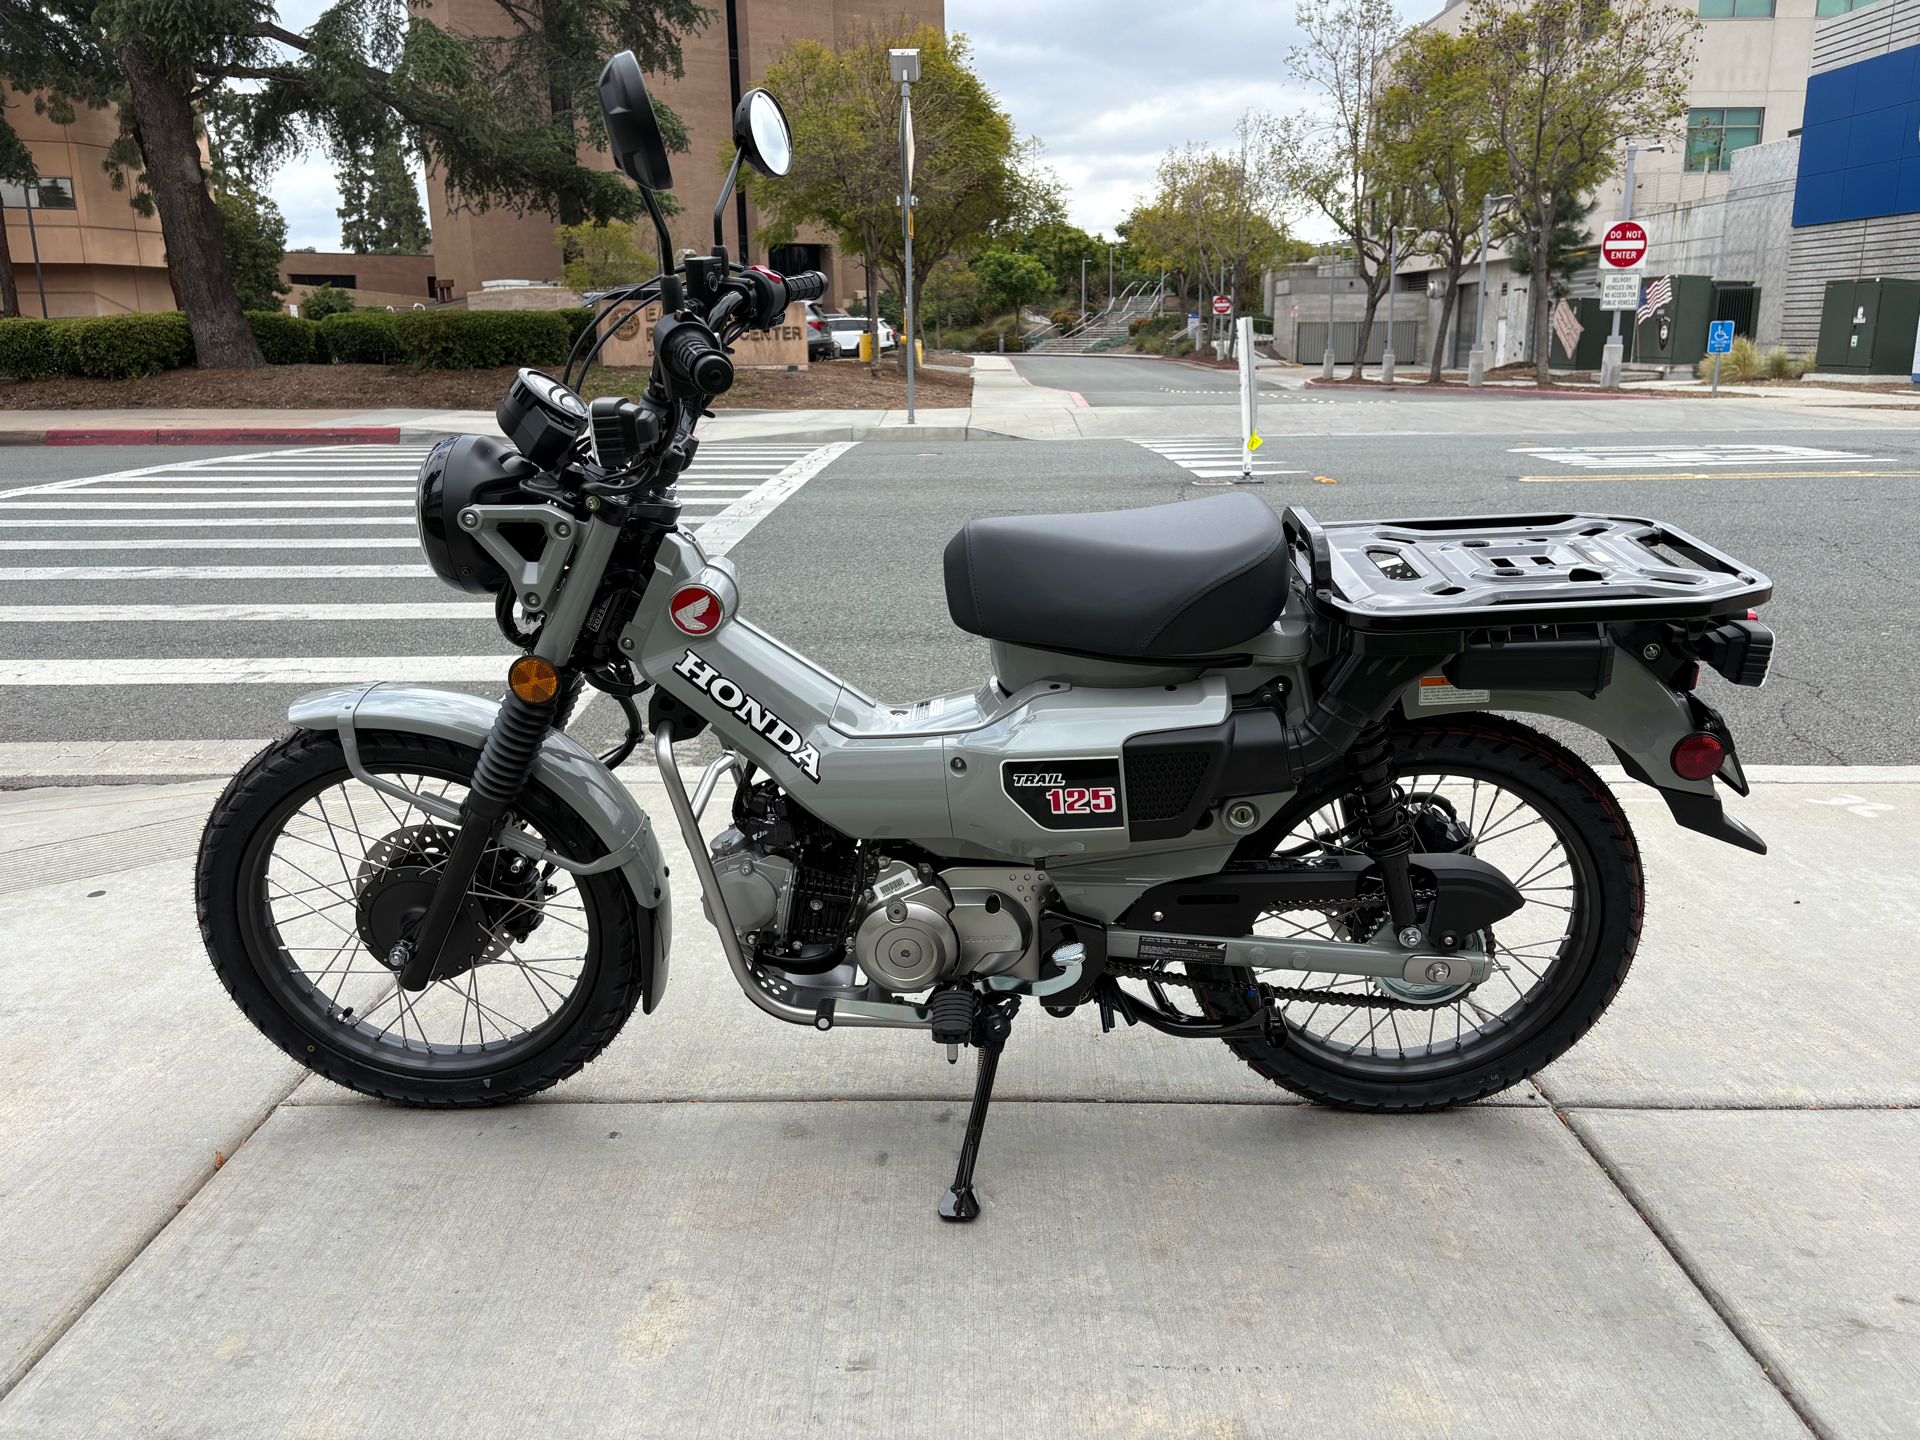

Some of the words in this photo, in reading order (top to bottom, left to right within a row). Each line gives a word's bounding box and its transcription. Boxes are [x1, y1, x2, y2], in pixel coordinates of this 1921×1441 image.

[1610, 231, 1622, 239] DO
[1626, 231, 1642, 239] NOT
[1611, 251, 1637, 259] ENTER
[673, 648, 821, 784] HONDA
[1013, 773, 1066, 786] TRAIL
[1046, 787, 1116, 814] 125
